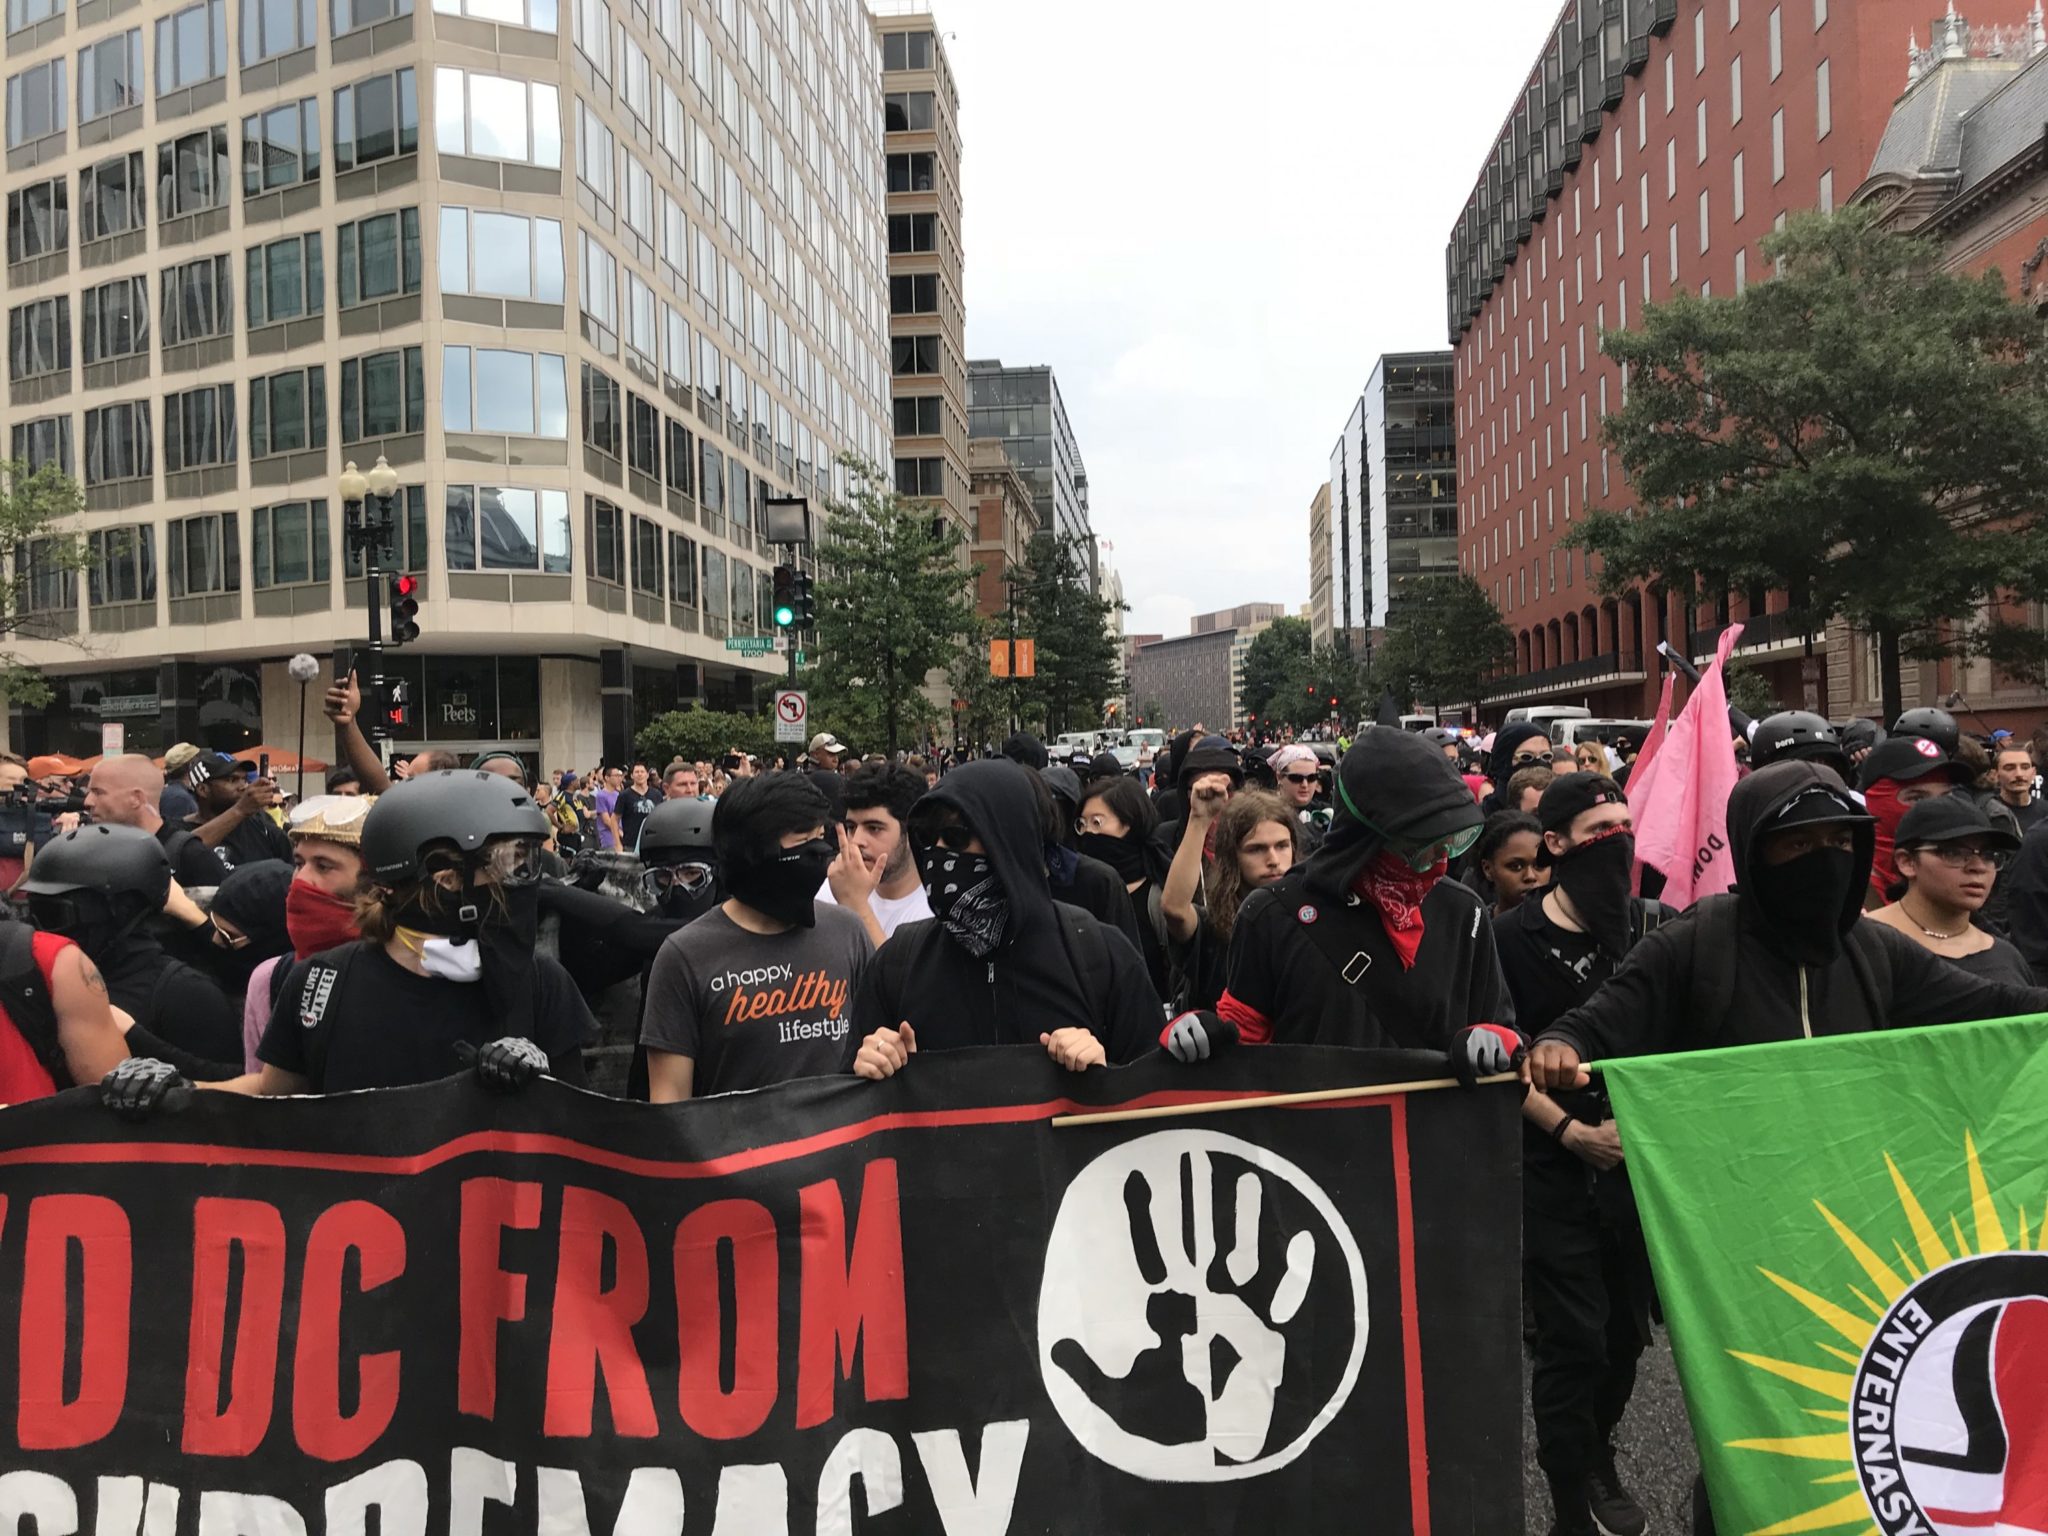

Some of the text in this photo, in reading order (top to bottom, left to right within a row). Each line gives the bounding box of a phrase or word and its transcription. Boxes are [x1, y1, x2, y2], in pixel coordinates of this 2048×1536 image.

[727, 638, 765, 650] PENNSYLVANIA
[743, 650, 764, 658] 1700
[305, 966, 321, 990] LIVES
[710, 963, 793, 992] a happy,
[724, 970, 848, 1026] healthy
[778, 1013, 850, 1043] lifestyle
[181, 1196, 406, 1462] DC
[457, 1158, 910, 1441] FROM
